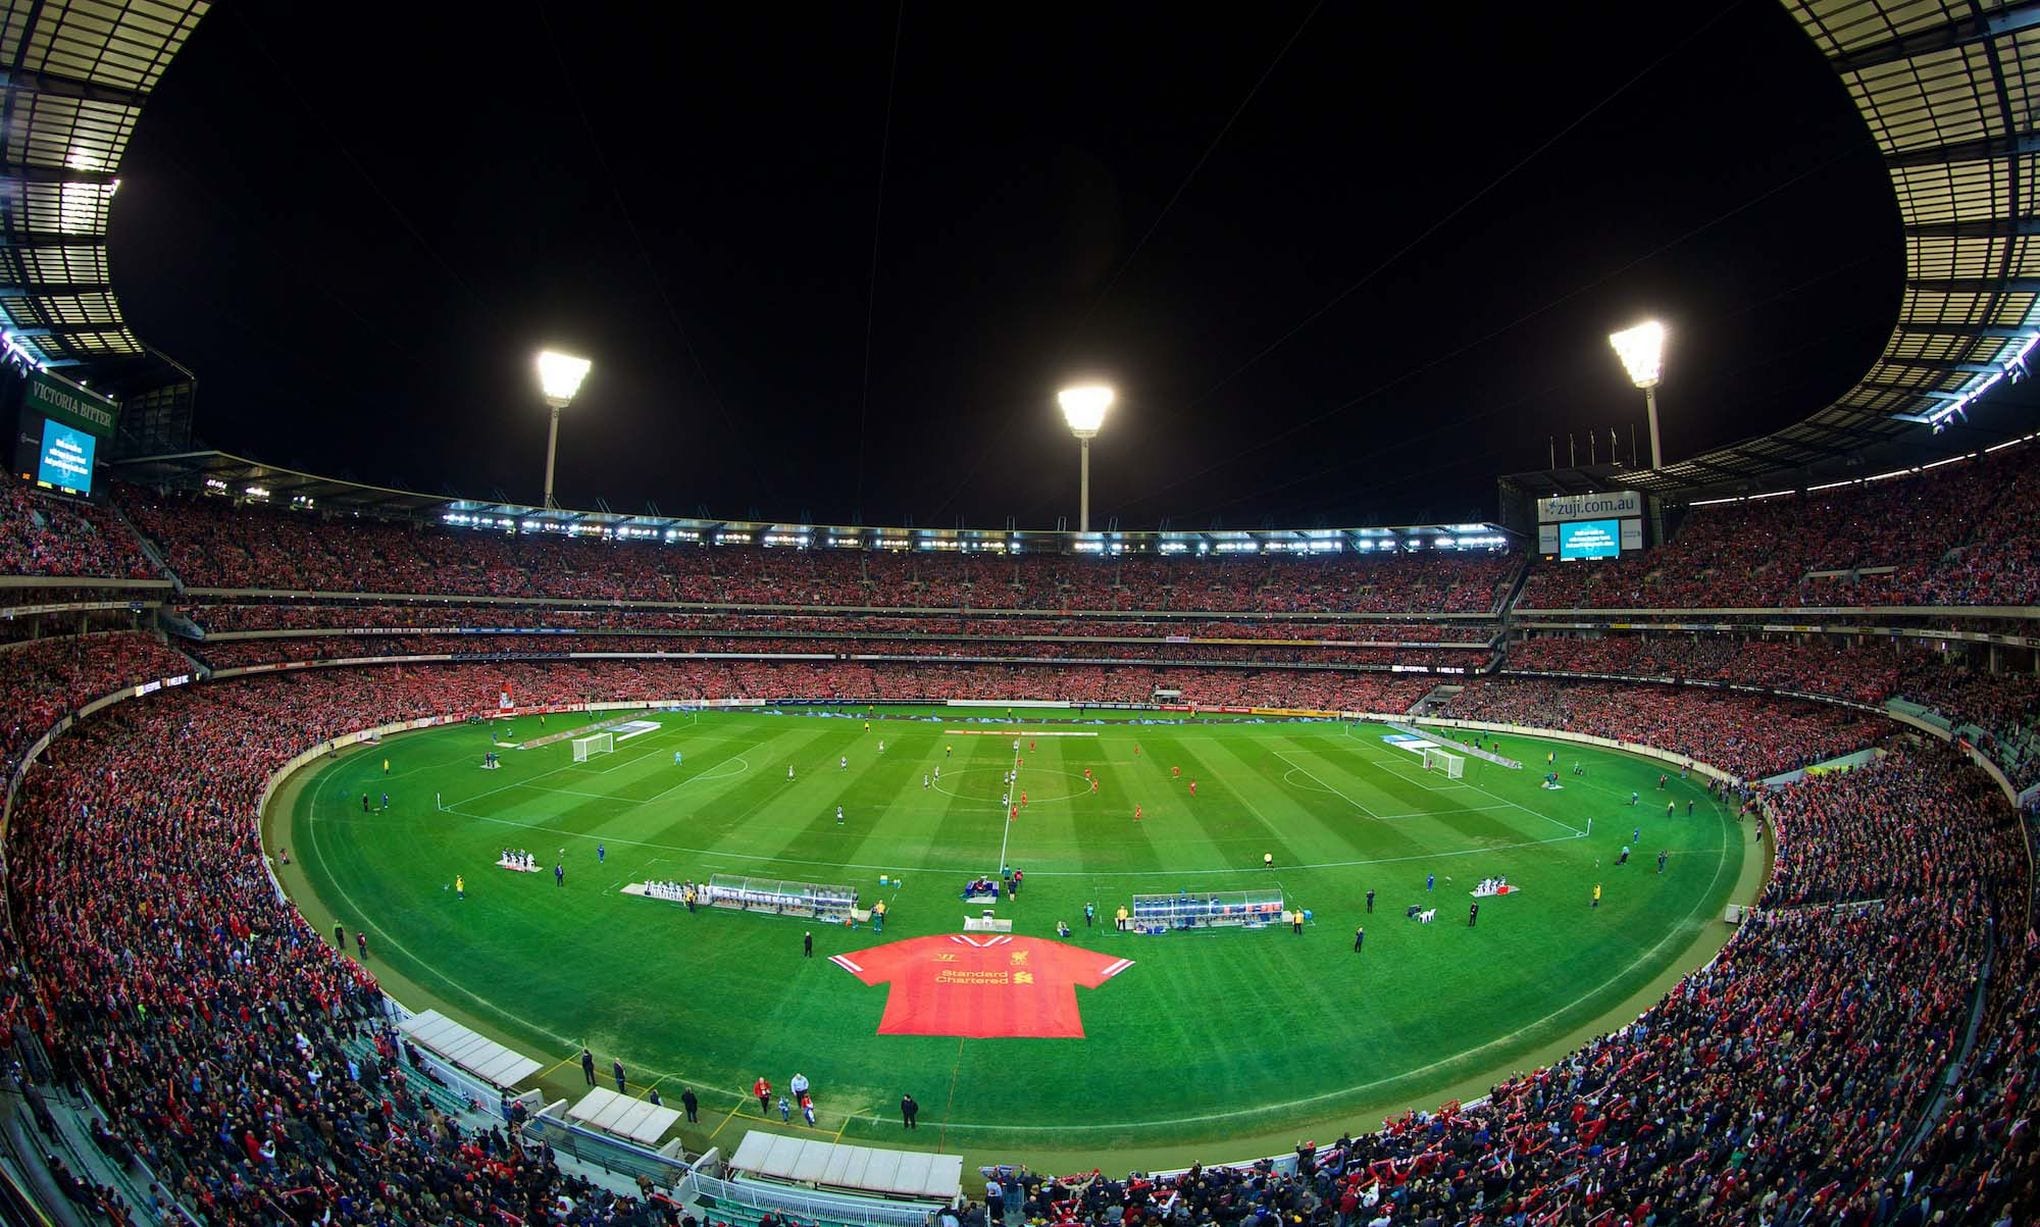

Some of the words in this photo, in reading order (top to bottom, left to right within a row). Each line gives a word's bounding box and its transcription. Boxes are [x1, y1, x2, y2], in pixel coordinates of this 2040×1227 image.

[33, 381, 79, 413] VICTORIA
[80, 402, 112, 427] BITTER
[1557, 498, 1634, 518] zuji.com.au
[936, 976, 1009, 985] Chartered
[941, 969, 1008, 978] Standard
